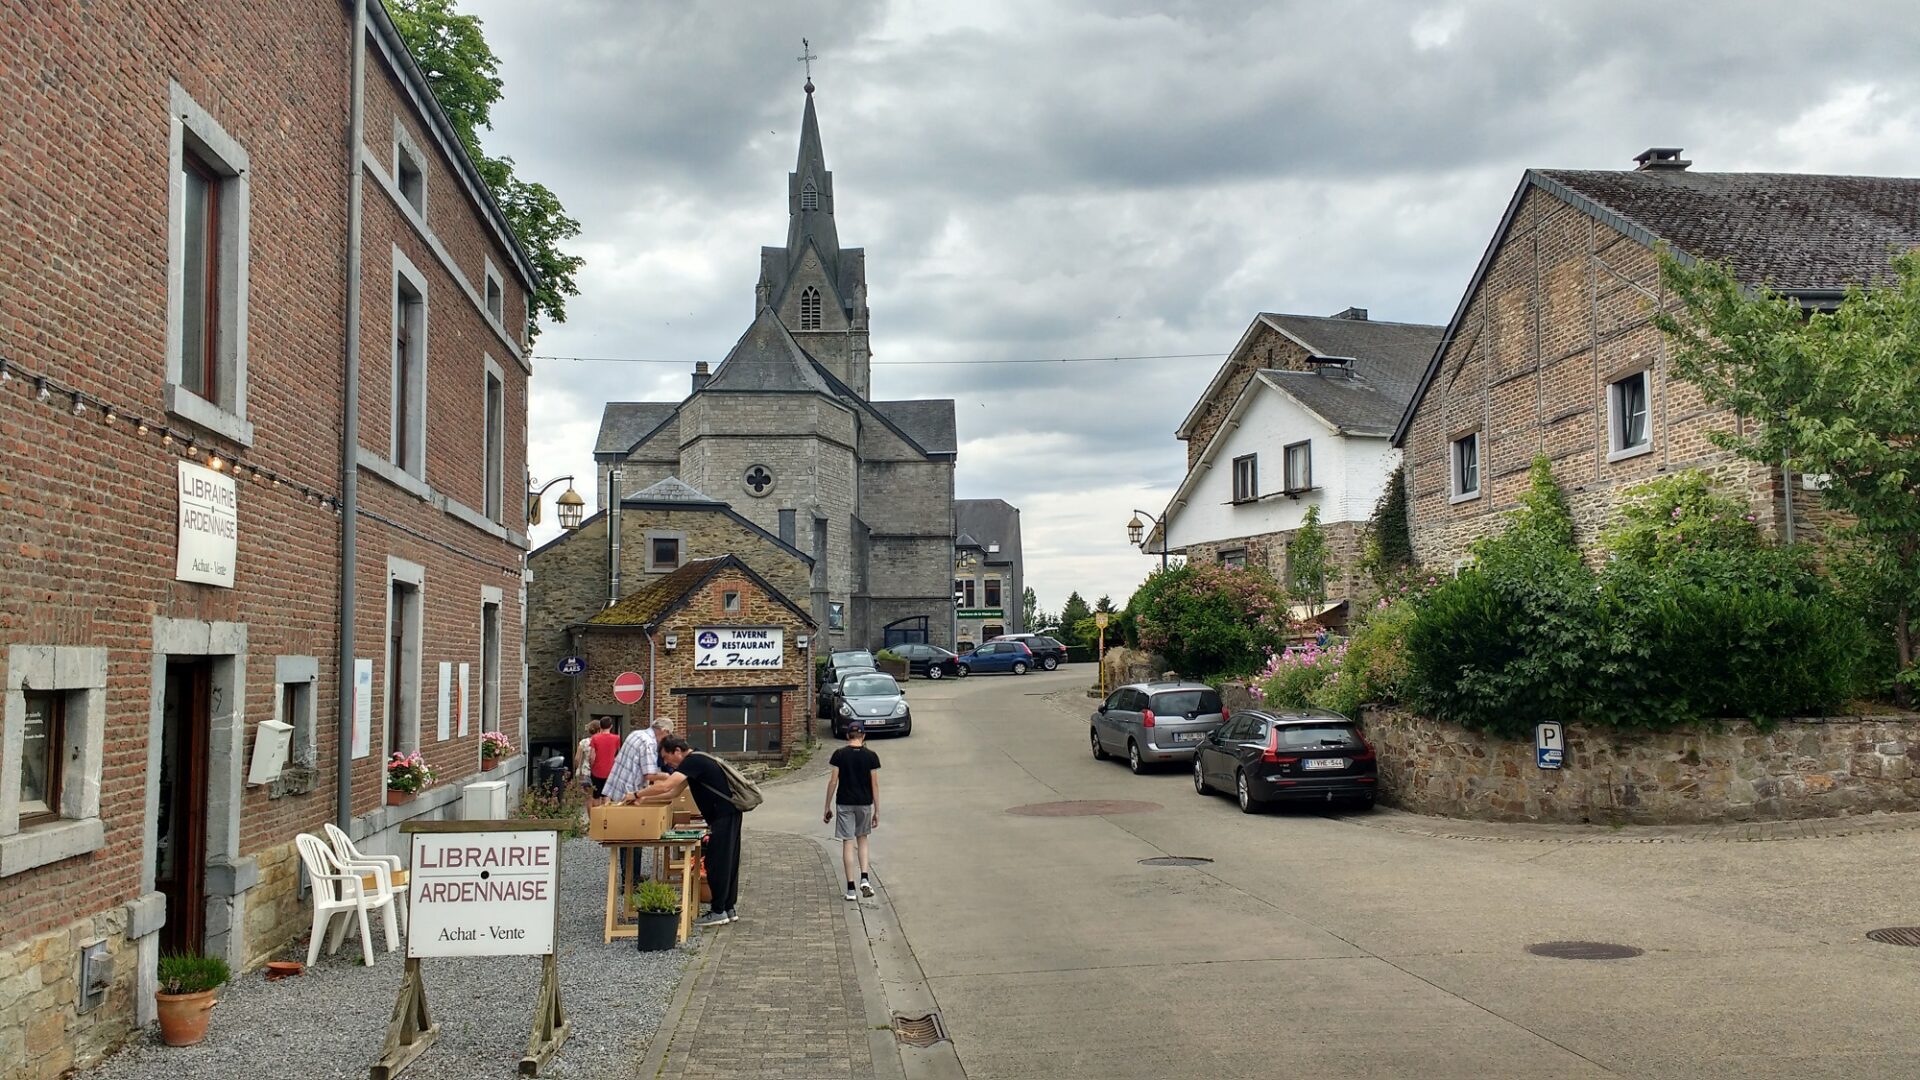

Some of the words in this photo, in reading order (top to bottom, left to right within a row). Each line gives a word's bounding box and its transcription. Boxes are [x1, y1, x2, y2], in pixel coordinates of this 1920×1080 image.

[182, 471, 235, 509] LIBRAIRIE
[183, 508, 235, 540] ARDENNAISE
[192, 558, 210, 573] Achat
[214, 561, 227, 576] Vente
[732, 630, 768, 639] TAVERNE
[722, 641, 775, 650] RESTAURANT
[697, 653, 718, 667] Le
[726, 652, 781, 667] Friand
[1543, 728, 1555, 746] P
[419, 845, 550, 868] LIBRAIRIE
[418, 880, 548, 903] ARDENNAISE
[438, 927, 477, 942] Achat
[489, 926, 525, 940] Vente
